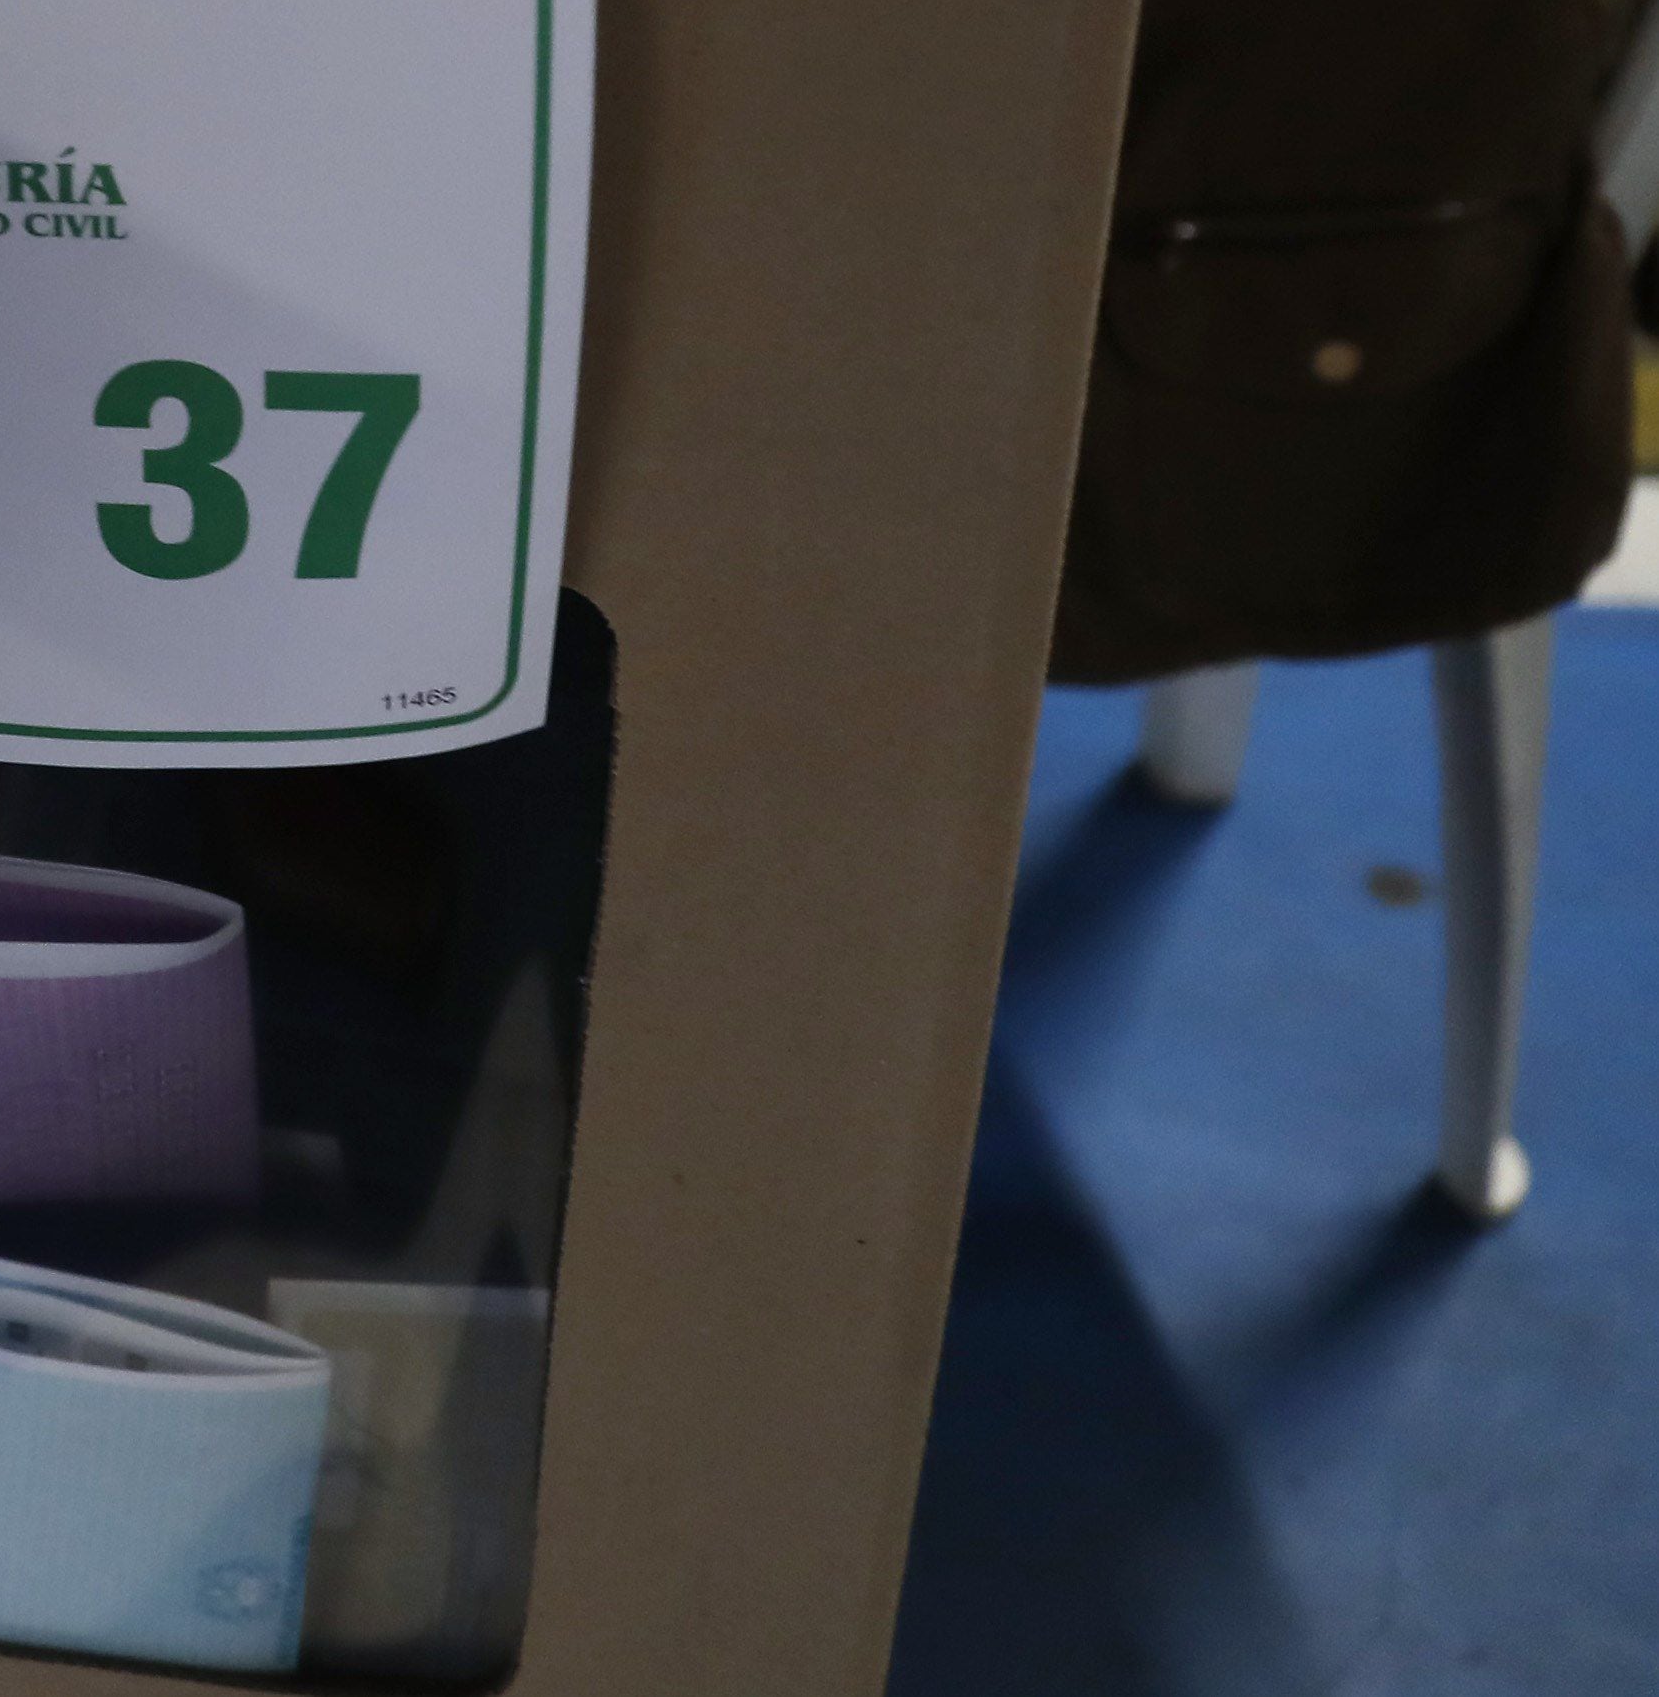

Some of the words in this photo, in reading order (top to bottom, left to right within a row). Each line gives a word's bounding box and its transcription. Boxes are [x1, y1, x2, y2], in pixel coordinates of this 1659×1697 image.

[24, 212, 129, 241] CIVIL
[92, 359, 421, 580] 37
[381, 686, 458, 711] 11465
